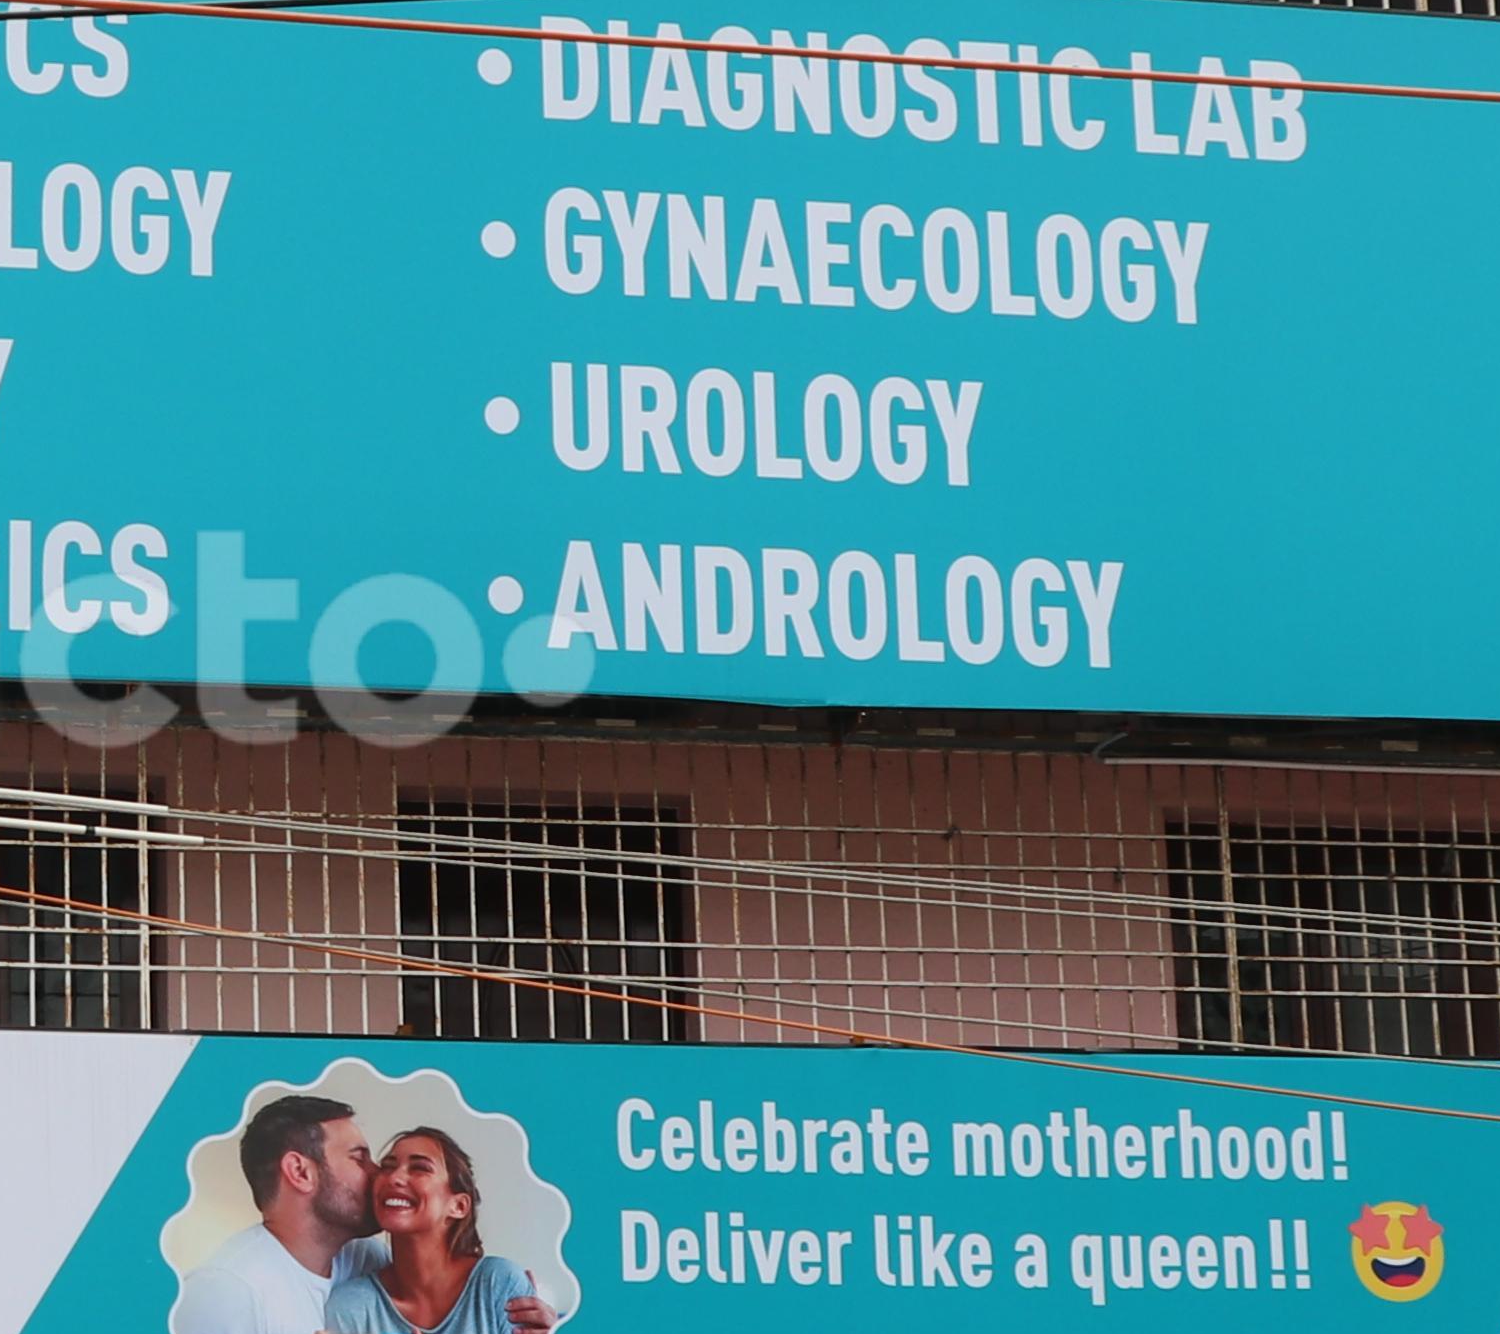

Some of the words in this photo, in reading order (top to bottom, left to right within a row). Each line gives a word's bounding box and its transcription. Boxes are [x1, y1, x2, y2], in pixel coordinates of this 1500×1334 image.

[540, 16, 1107, 153] DIAGNOSTIC
[1131, 46, 1307, 164] LAB
[543, 185, 1211, 328] GYNAECOLOGY
[549, 360, 984, 489] UROLOGY
[547, 537, 1126, 670] ANDROLOGY
[616, 1097, 931, 1177] Celebrate
[952, 1108, 1349, 1181] motherhood!
[620, 1210, 851, 1287] Deliver
[872, 1214, 993, 1288] like
[1014, 1234, 1049, 1288] a
[1070, 1219, 1313, 1306] queen!!
